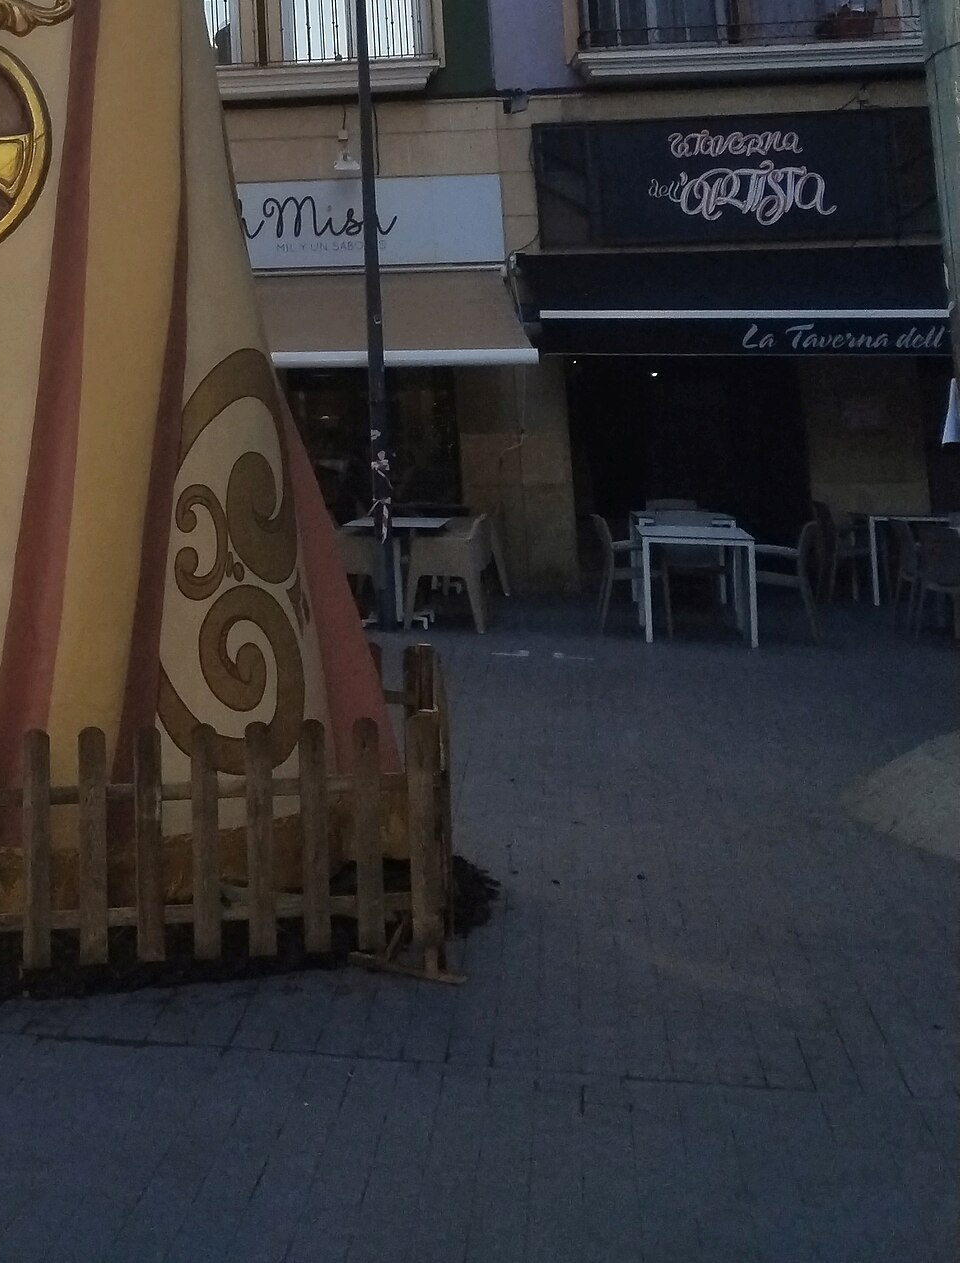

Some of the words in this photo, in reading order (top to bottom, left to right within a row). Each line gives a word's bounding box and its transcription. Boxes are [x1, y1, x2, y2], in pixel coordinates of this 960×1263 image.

[310, 241, 328, 252] UN
[332, 239, 386, 252] SABOS
[742, 323, 775, 349] La
[785, 322, 889, 349] Taverna
